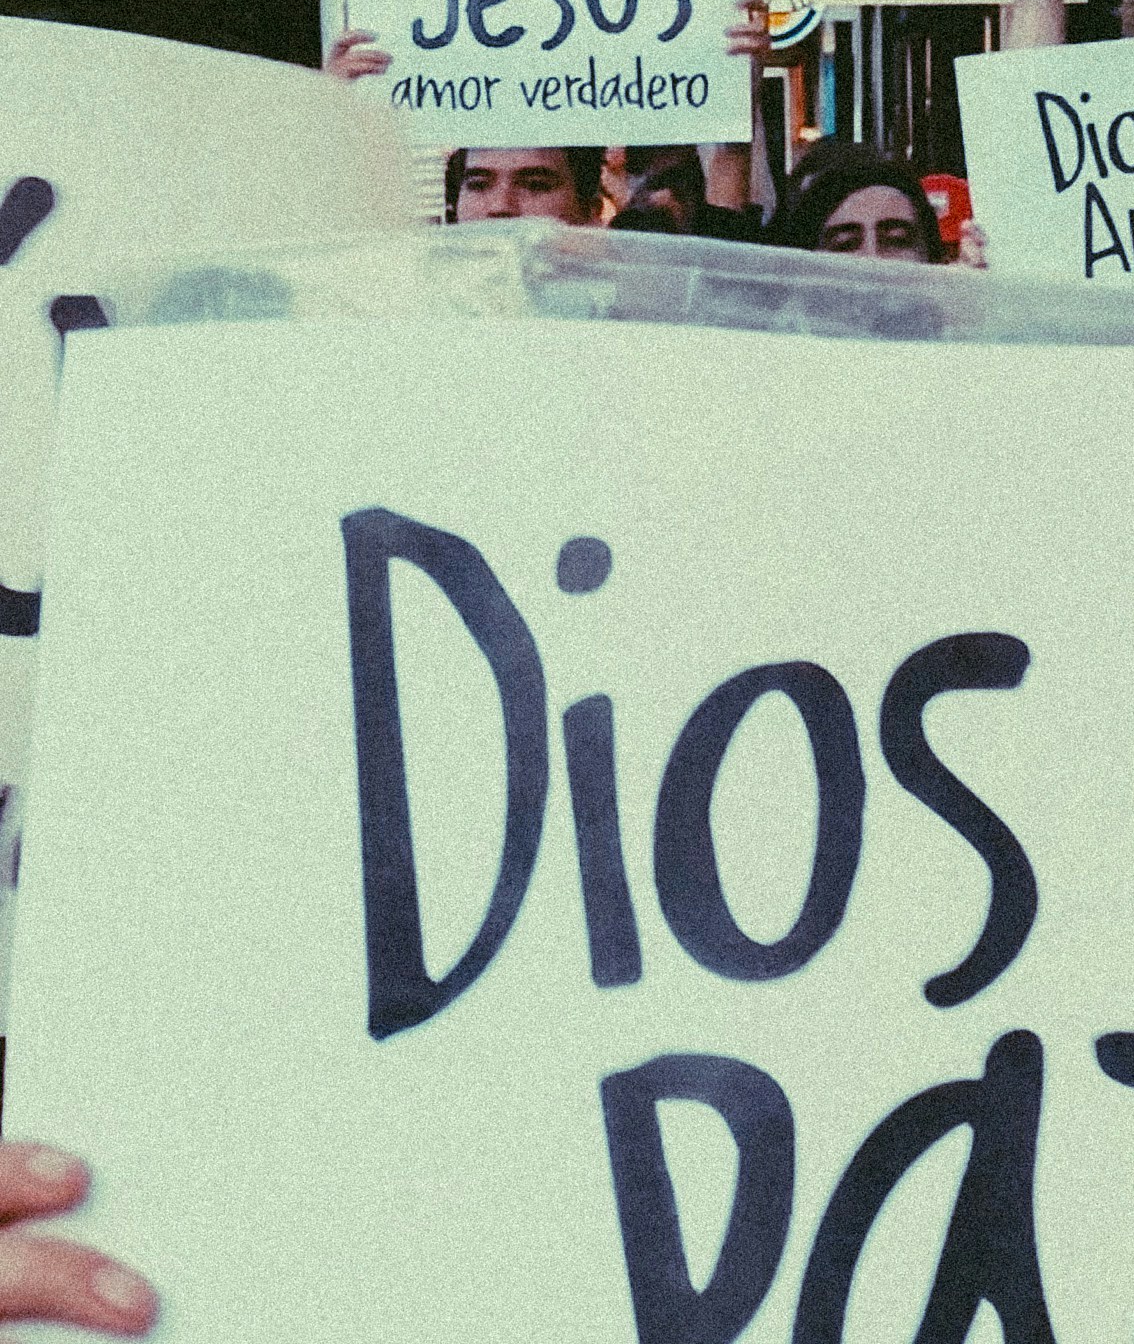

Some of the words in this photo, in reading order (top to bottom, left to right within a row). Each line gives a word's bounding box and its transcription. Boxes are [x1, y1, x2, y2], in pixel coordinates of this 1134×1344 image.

[391, 73, 501, 111] amor
[519, 54, 710, 112] verdadero
[341, 506, 1044, 1043] Dios
